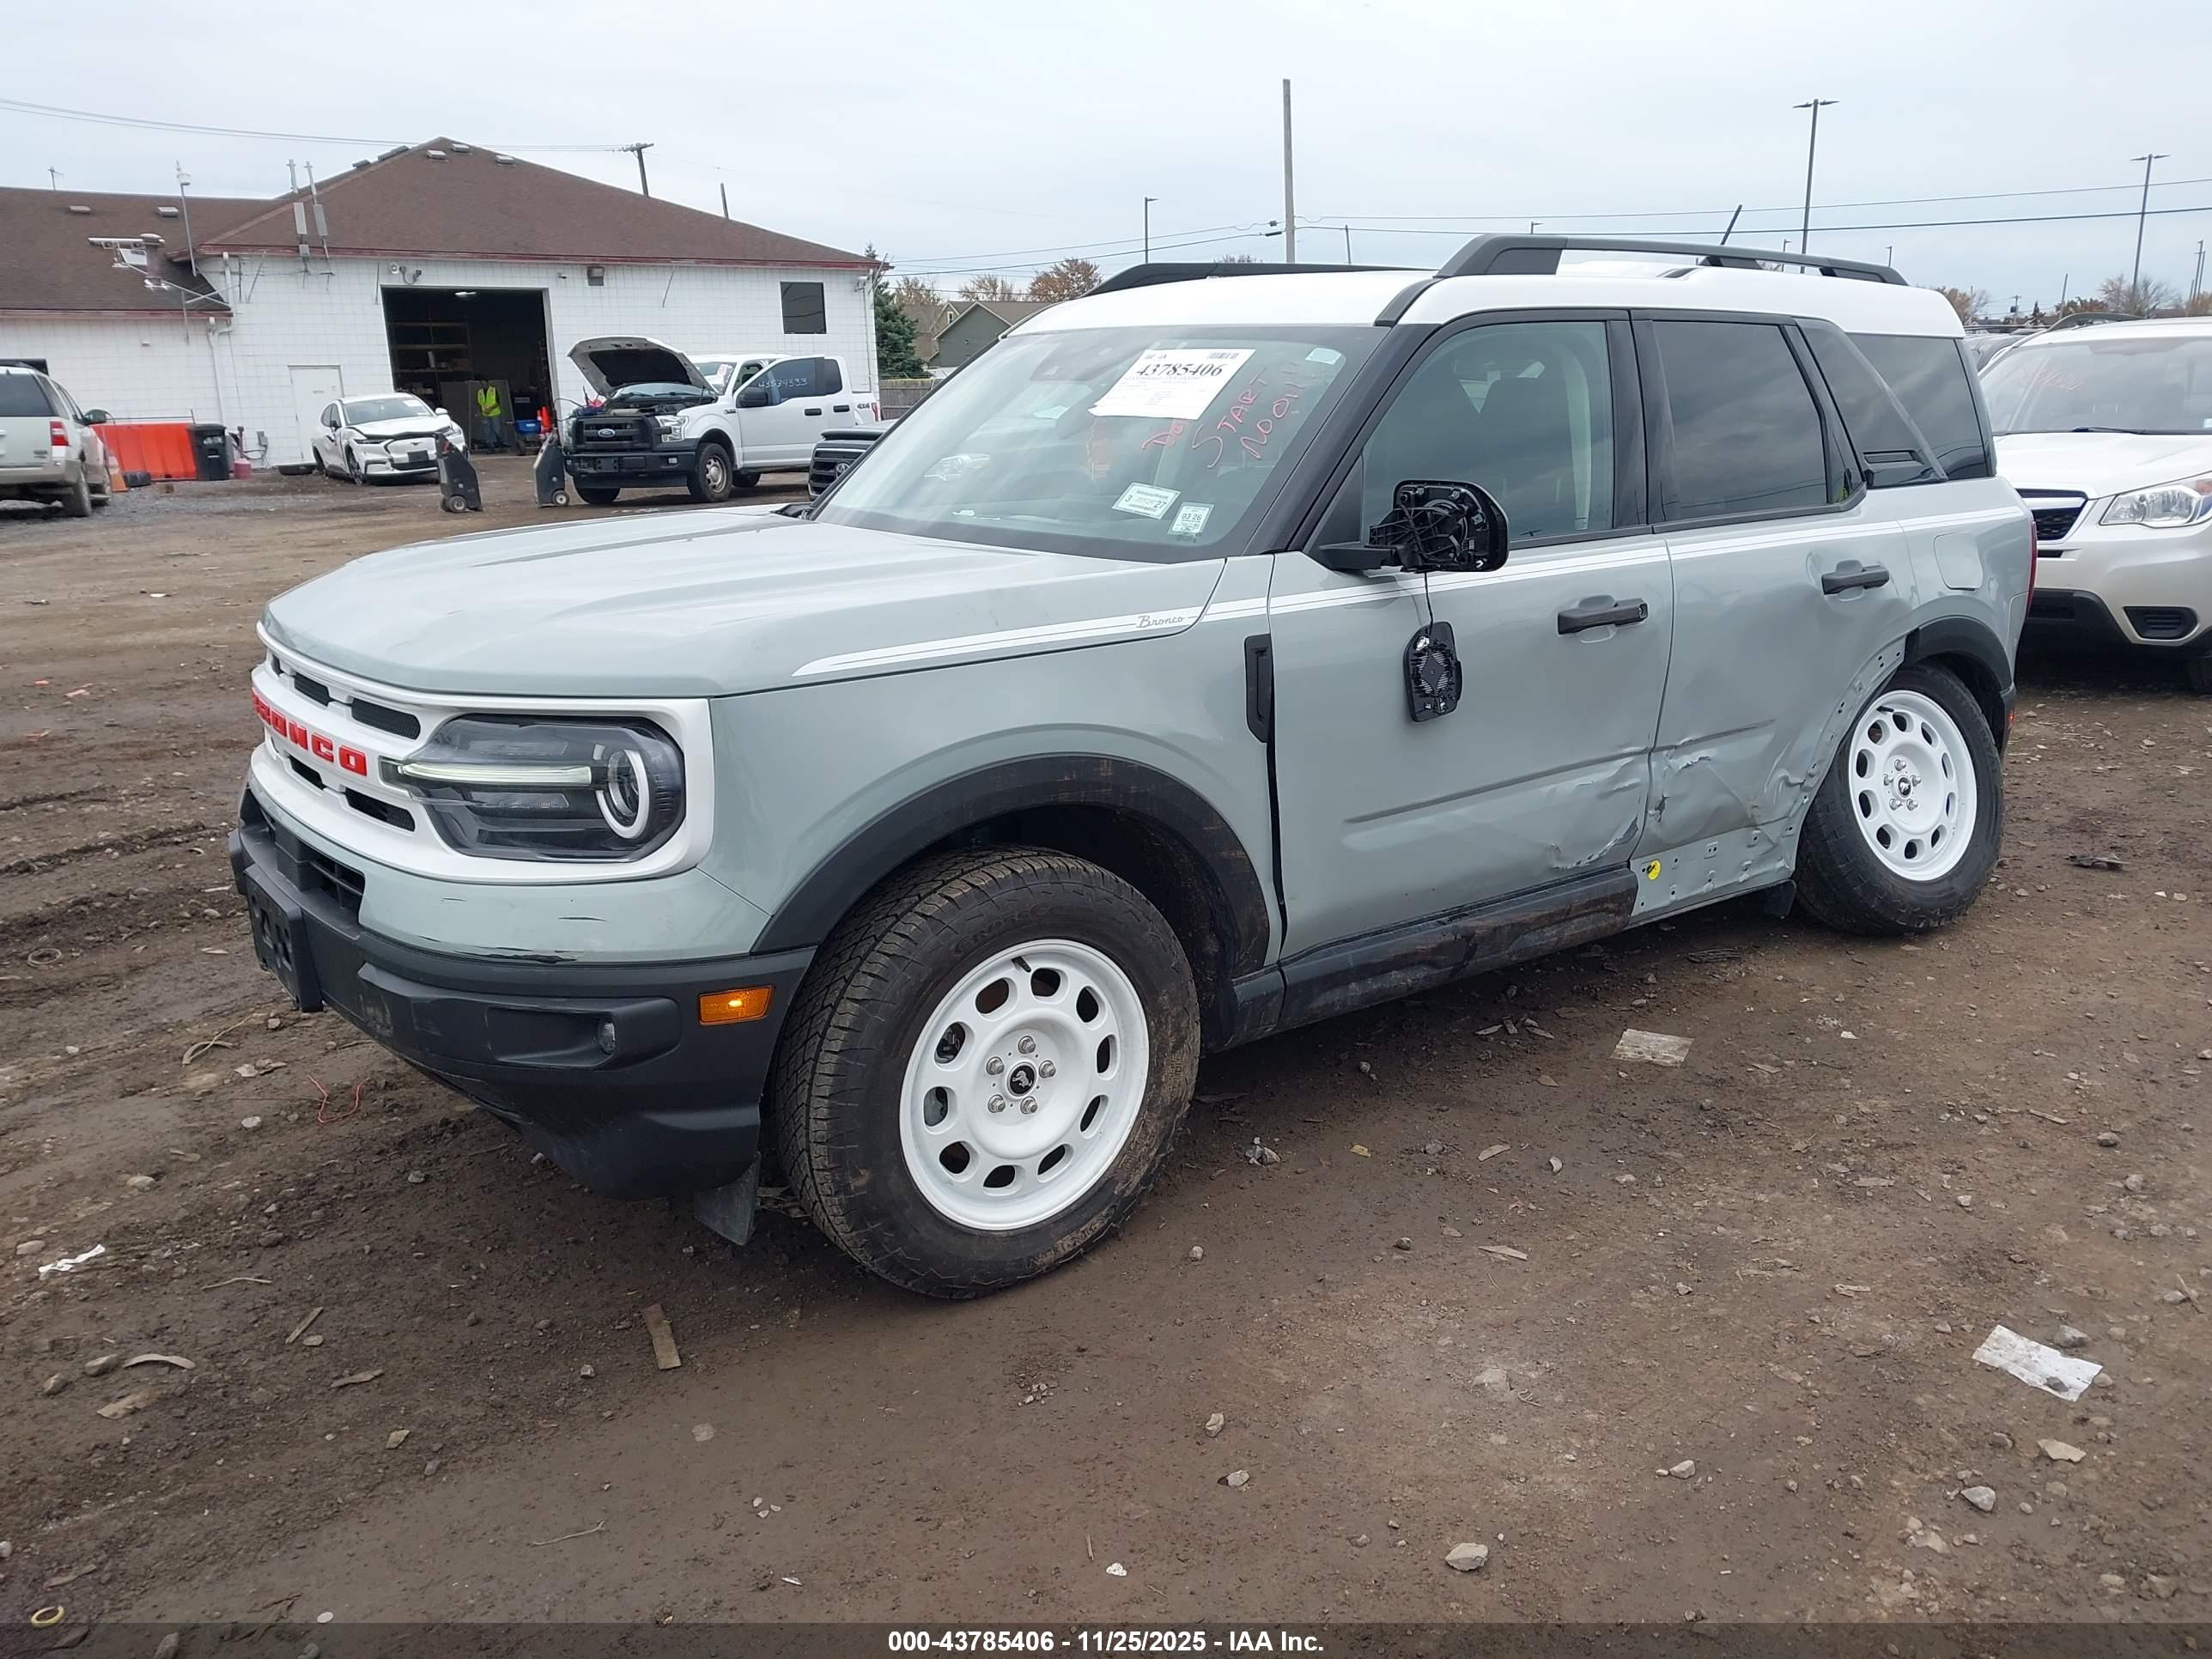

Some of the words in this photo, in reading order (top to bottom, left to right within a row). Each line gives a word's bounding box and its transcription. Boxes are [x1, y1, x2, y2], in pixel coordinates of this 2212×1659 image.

[1137, 362, 1228, 377] 43785406
[1153, 500, 1168, 509] 27
[1136, 615, 1186, 629] Bronco
